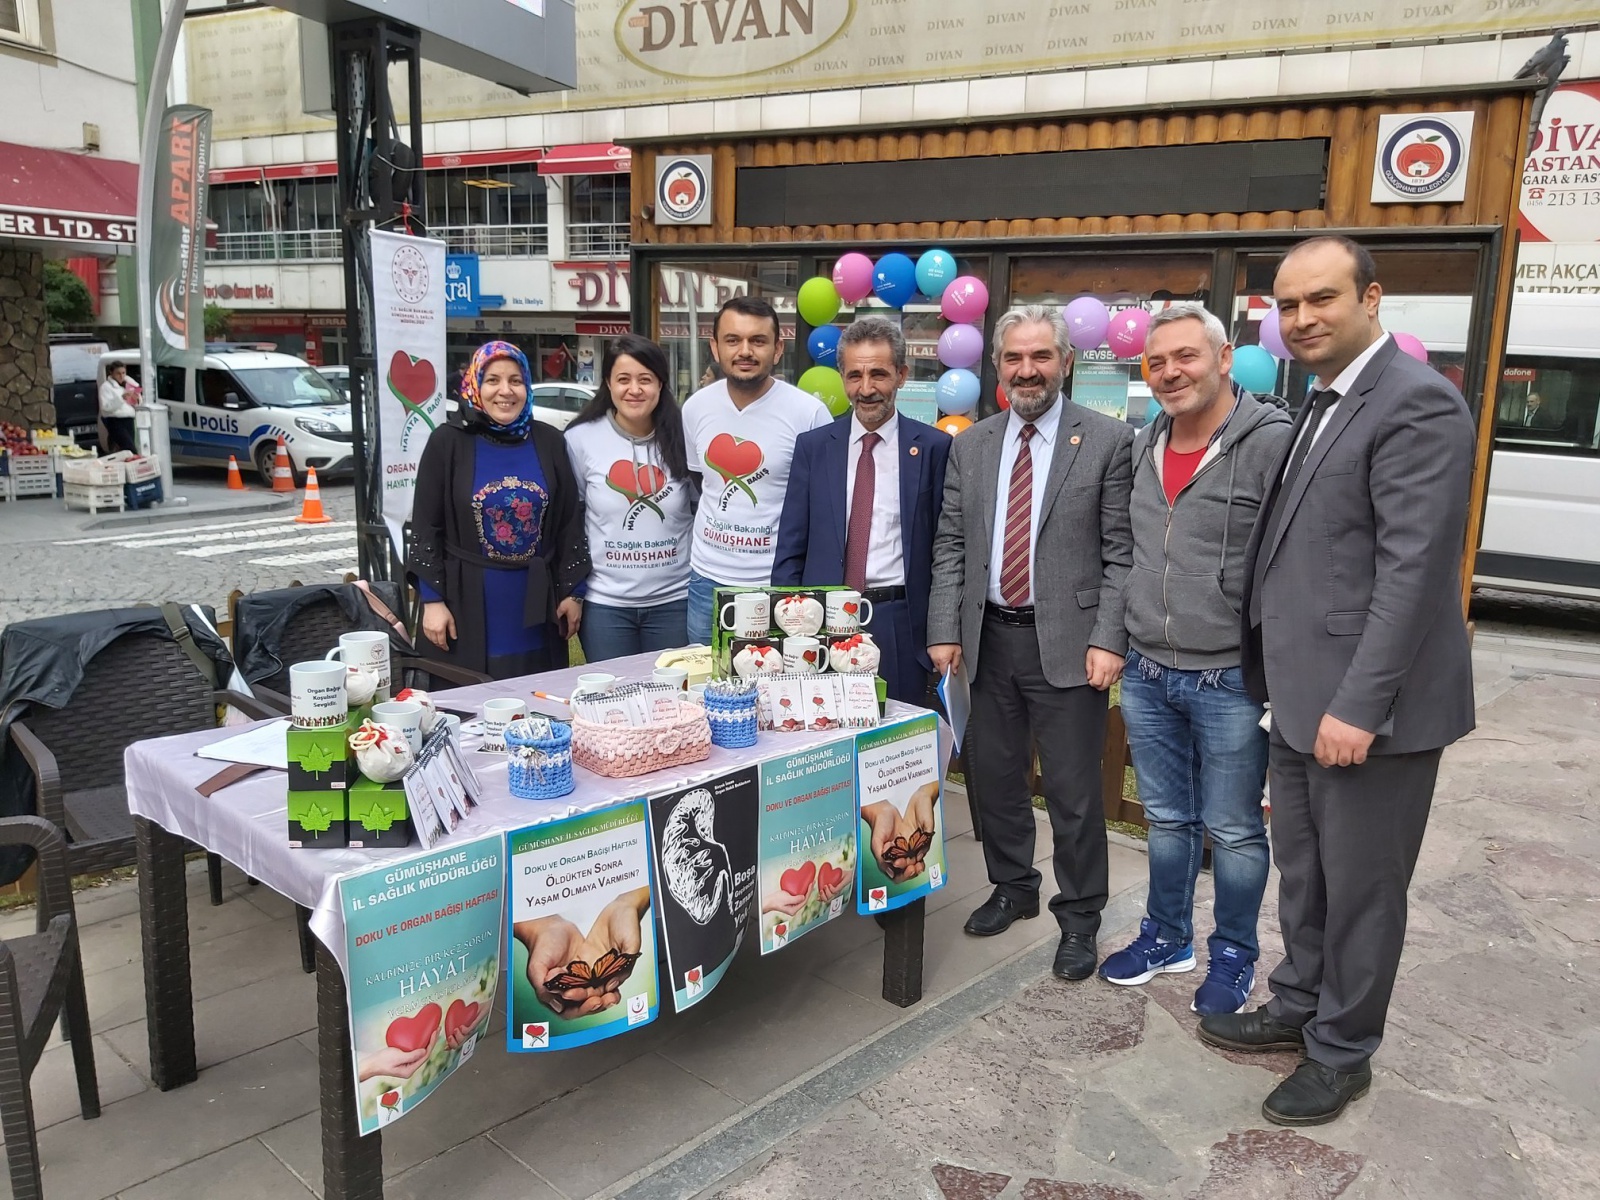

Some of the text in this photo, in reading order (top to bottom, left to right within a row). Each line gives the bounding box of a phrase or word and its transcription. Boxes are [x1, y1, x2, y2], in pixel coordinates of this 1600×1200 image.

[639, 0, 813, 52] DİVAN
[868, 55, 905, 67] DİVAN
[170, 117, 192, 225] APART
[1524, 154, 1600, 172] ASTAN
[1385, 170, 1451, 193] GÜMÜŞHANE BELEDİYESİ
[1547, 192, 1576, 206] 213
[0, 216, 36, 234] ER
[43, 217, 102, 240] LTD.
[1551, 263, 1600, 282] AKÇA
[600, 325, 630, 335] DİVA
[200, 414, 239, 434] POLİS
[403, 417, 419, 452] HAYATA
[387, 463, 416, 475] ORGAN
[387, 478, 409, 490] HAYAT
[721, 467, 770, 511] HAYATA BAĞIŞ
[628, 504, 646, 531] HAYATA
[713, 520, 732, 532] Sağlık
[734, 524, 773, 536] Bakanlığı
[617, 540, 642, 550] Sağlık
[644, 536, 678, 549] Bakanlığı
[703, 527, 771, 547] GÜMÜŞHANE
[606, 547, 677, 563] GÜMÜŞHANE
[766, 752, 851, 786] İL SAĞLIK MÜDÜRLÜĞÜ
[786, 748, 834, 769] GÜMÜŞHANE
[878, 759, 923, 779] ÖLDÜKTEN SONRA
[766, 779, 851, 812] DOKU VE ORGAN BAĞIŞI HAFTASI
[867, 782, 888, 795] YAŞAM
[887, 775, 907, 788] OLMAYA
[518, 834, 565, 852] GÜMÜŞHANE
[574, 826, 599, 839] SAĞLIK
[790, 826, 834, 854] HAYAT
[385, 851, 467, 885] GÜMÜŞHANE
[524, 863, 547, 876] DOKU
[549, 861, 558, 869] VE
[560, 853, 586, 866] ORGAN
[611, 838, 638, 851] HAFTASI
[352, 855, 498, 912] İL SAĞLIK MÜDÜRLÜĞÜ
[545, 859, 624, 887] ÖLDÜKTEN SONRA
[734, 864, 756, 887] Boşa
[525, 869, 640, 908] YAŞAM OLMAYA VARMISIN?
[734, 890, 754, 912] Zaman
[355, 889, 498, 948] DOKU VE ORGAN BAĞIŞI HAFTASI
[463, 929, 493, 950] SORUN
[399, 952, 470, 999] HAYAT
